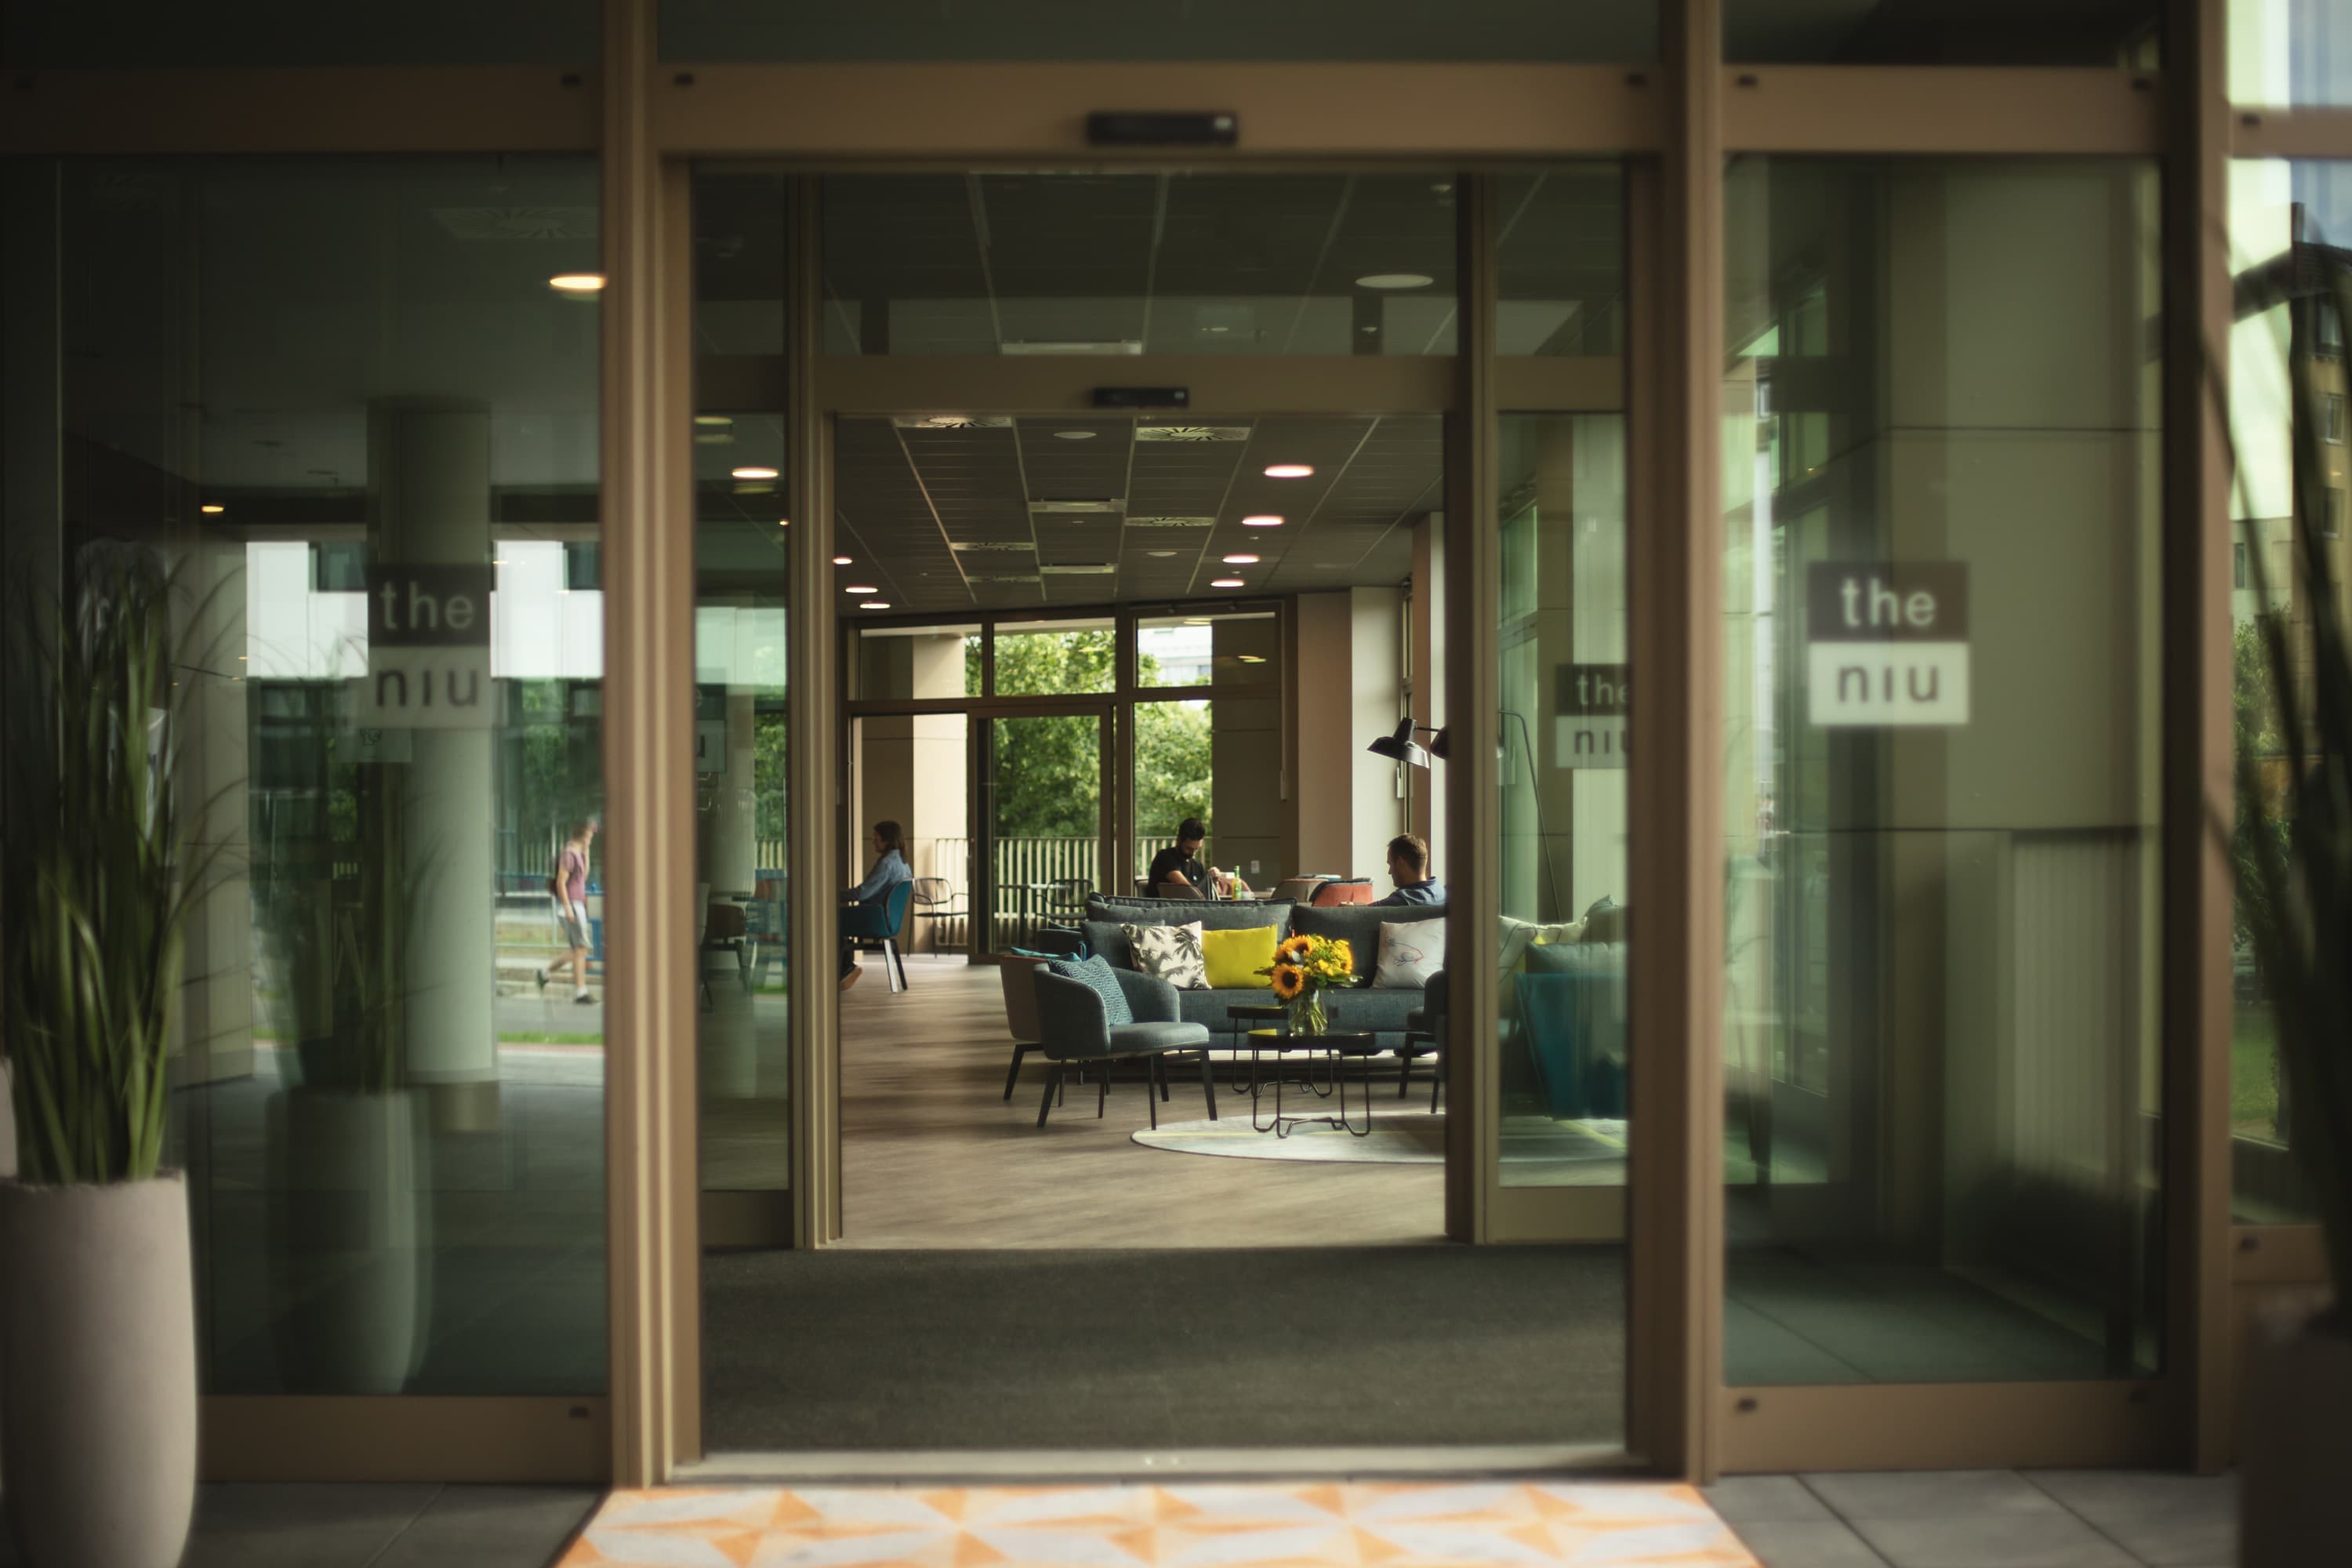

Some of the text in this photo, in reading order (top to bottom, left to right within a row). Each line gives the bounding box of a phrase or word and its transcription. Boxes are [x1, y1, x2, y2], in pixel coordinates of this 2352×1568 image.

[379, 581, 474, 630] the
[1841, 577, 1936, 627] the
[375, 669, 478, 707] niu
[1838, 666, 1939, 703] niu
